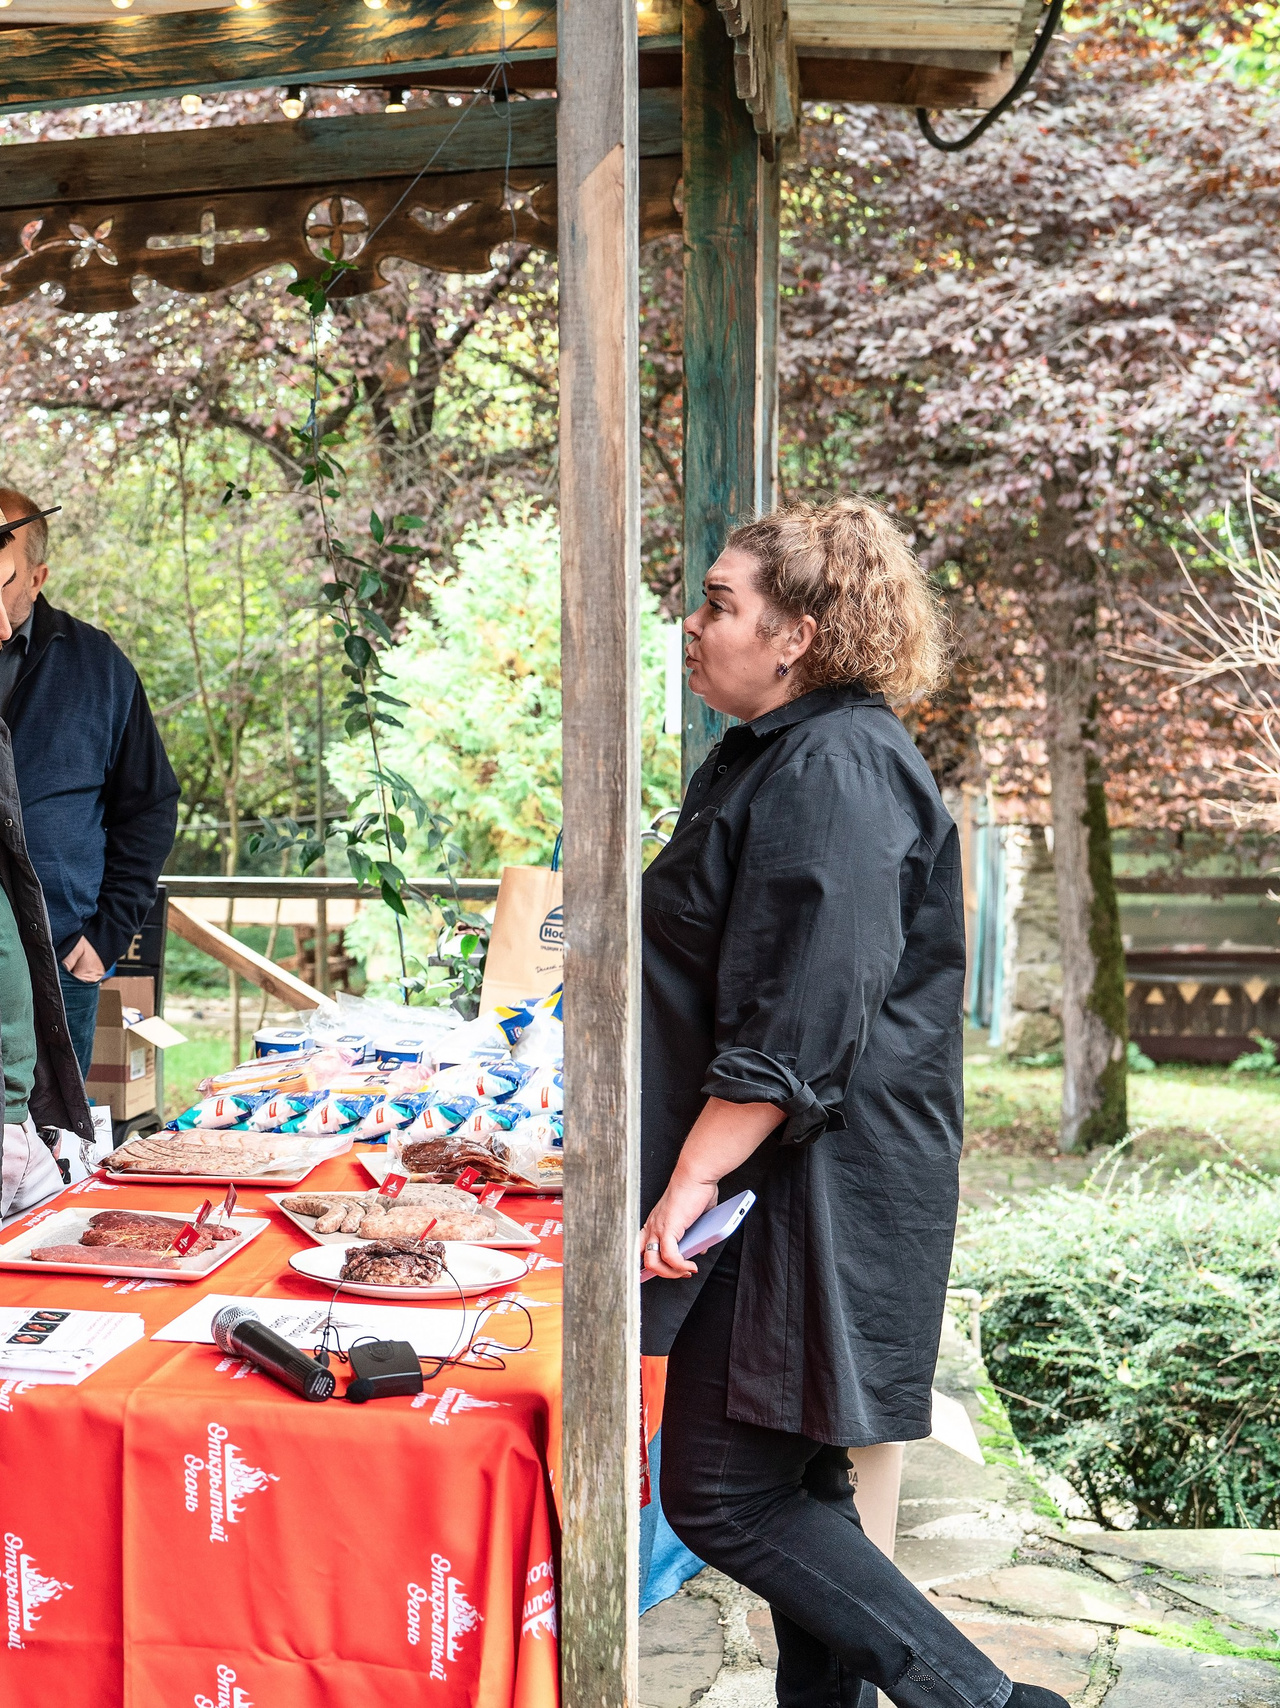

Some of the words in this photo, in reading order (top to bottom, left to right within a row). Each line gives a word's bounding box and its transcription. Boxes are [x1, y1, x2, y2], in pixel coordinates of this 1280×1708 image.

[184, 1453, 204, 1512] Огонь
[205, 1422, 229, 1544] Открытый
[2, 1532, 26, 1650] Открытый
[407, 1582, 428, 1645] Огонь
[428, 1553, 452, 1681] Открытый
